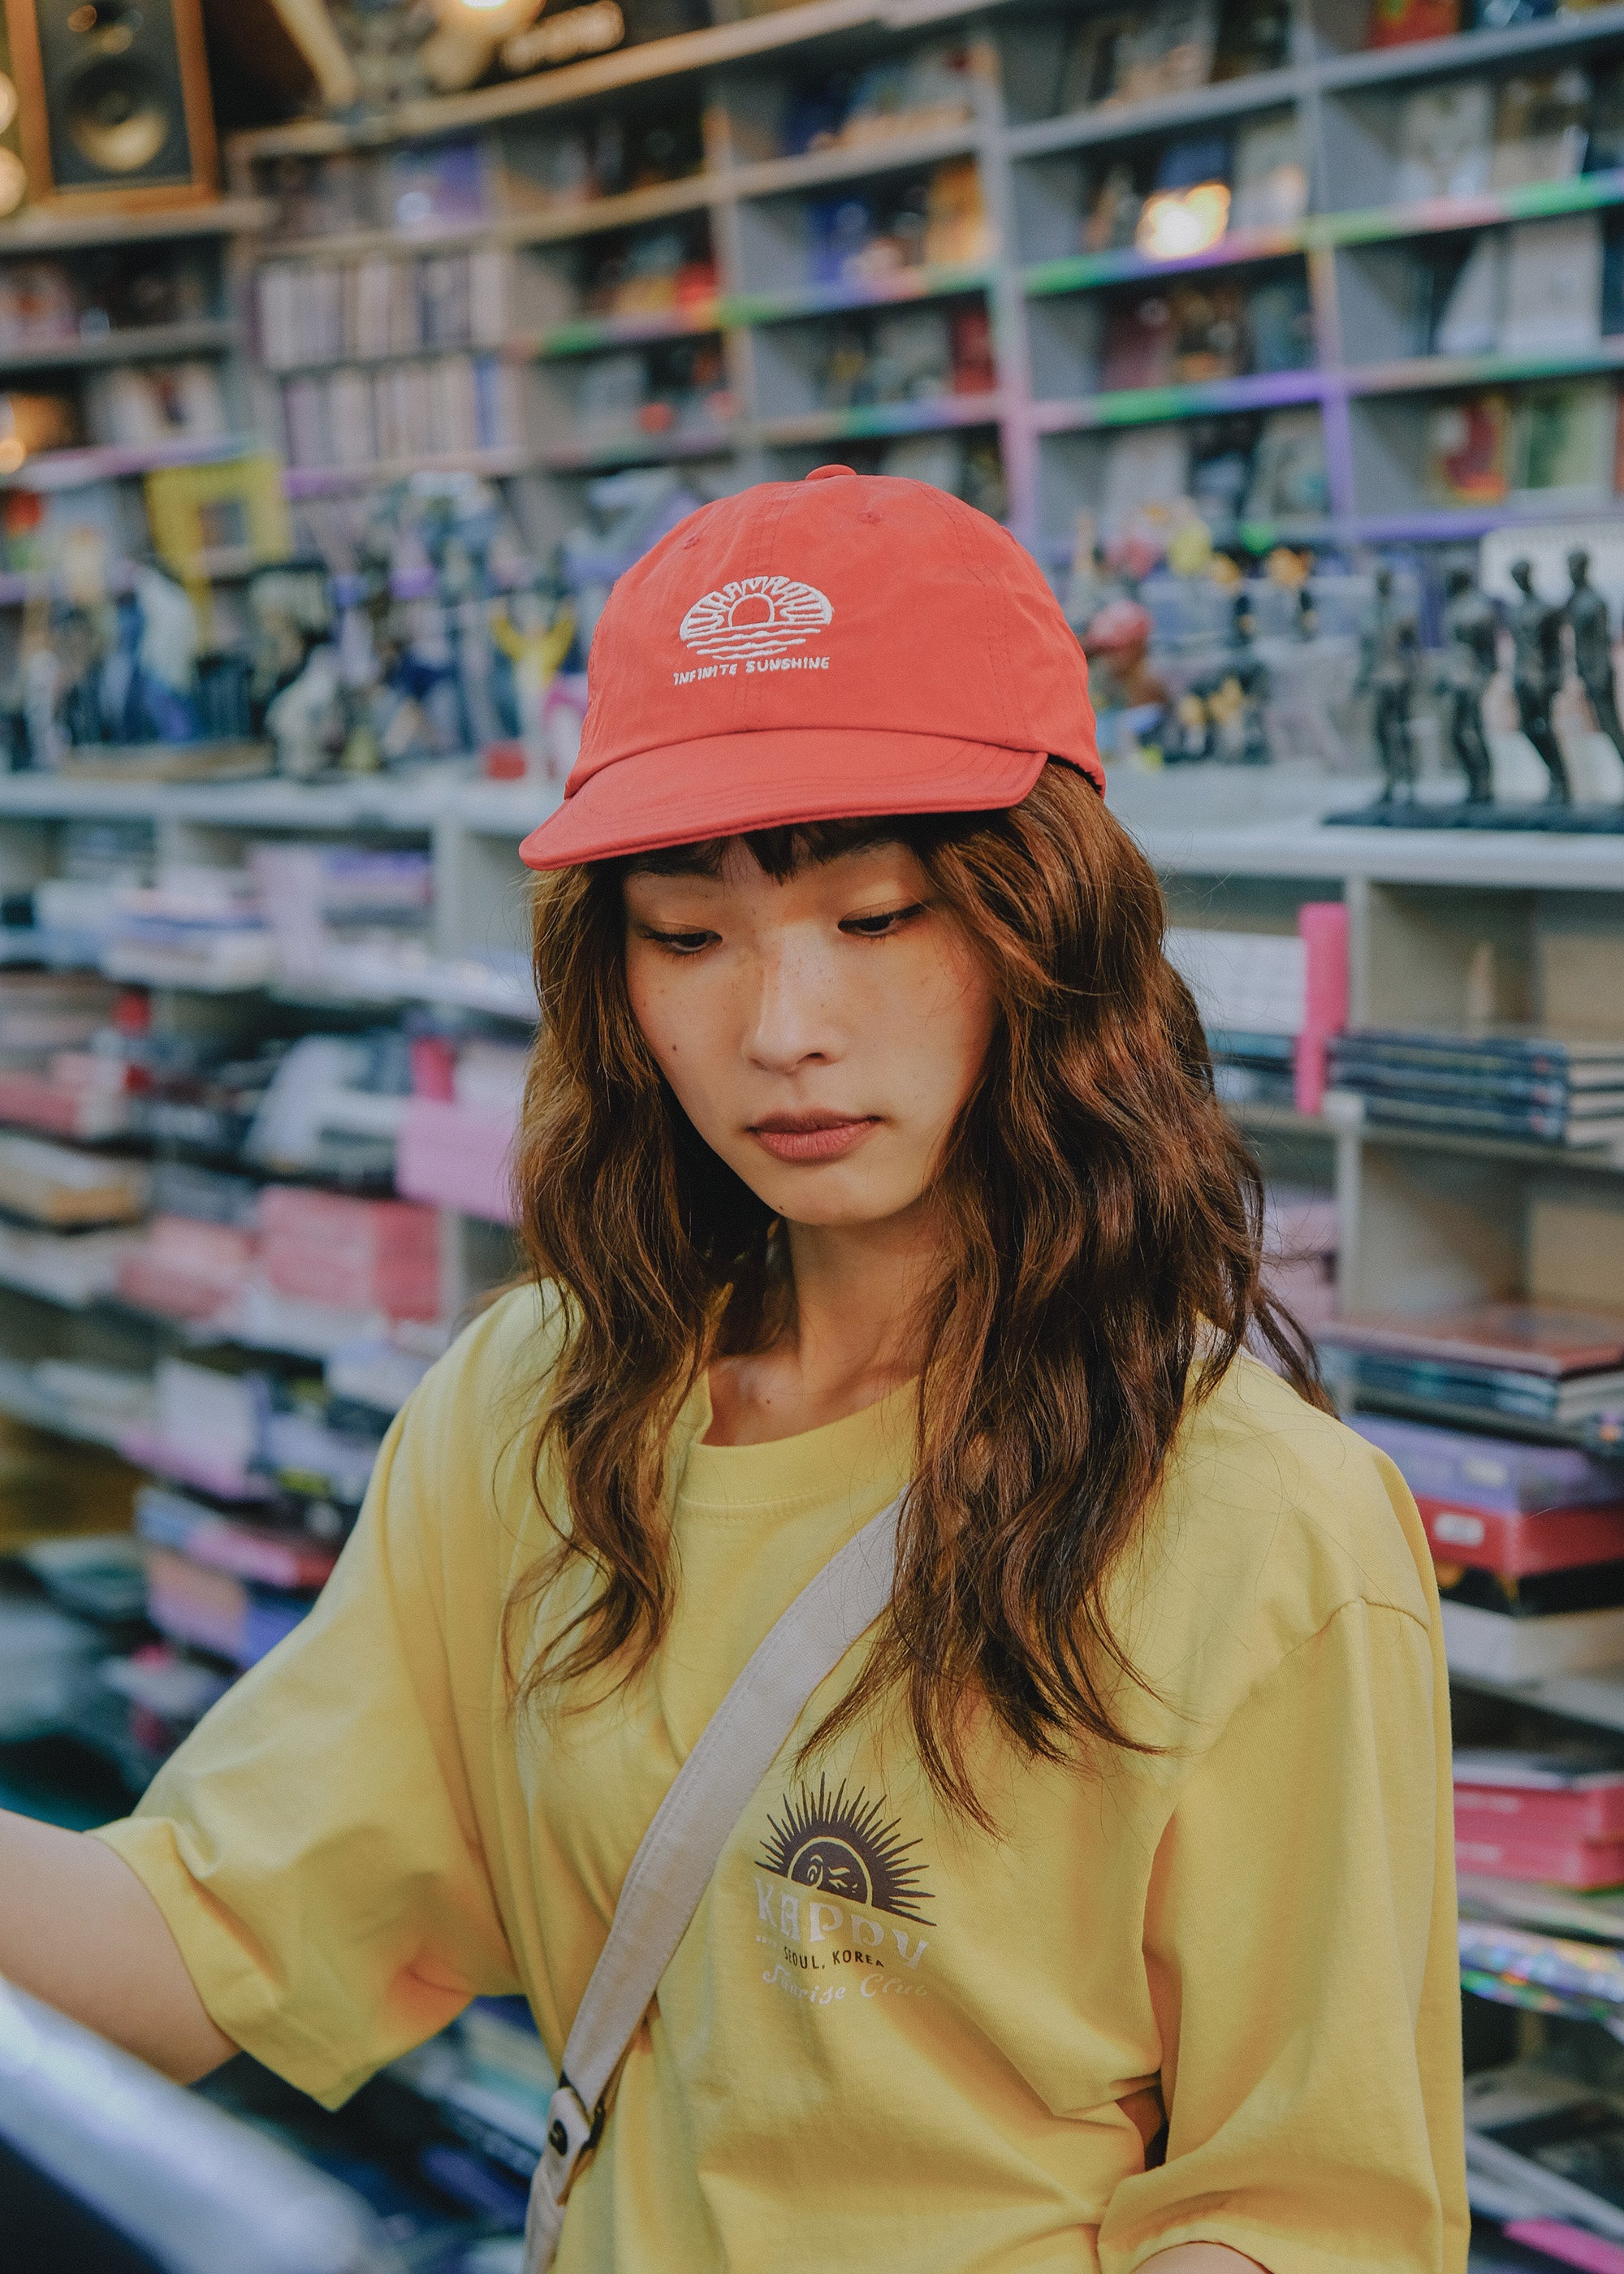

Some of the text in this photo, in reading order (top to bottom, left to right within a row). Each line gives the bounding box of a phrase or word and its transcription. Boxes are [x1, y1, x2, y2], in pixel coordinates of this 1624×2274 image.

[672, 656, 830, 685] INFINITE SUNSHINE
[784, 1946, 884, 1969] SEOUL, KOREA
